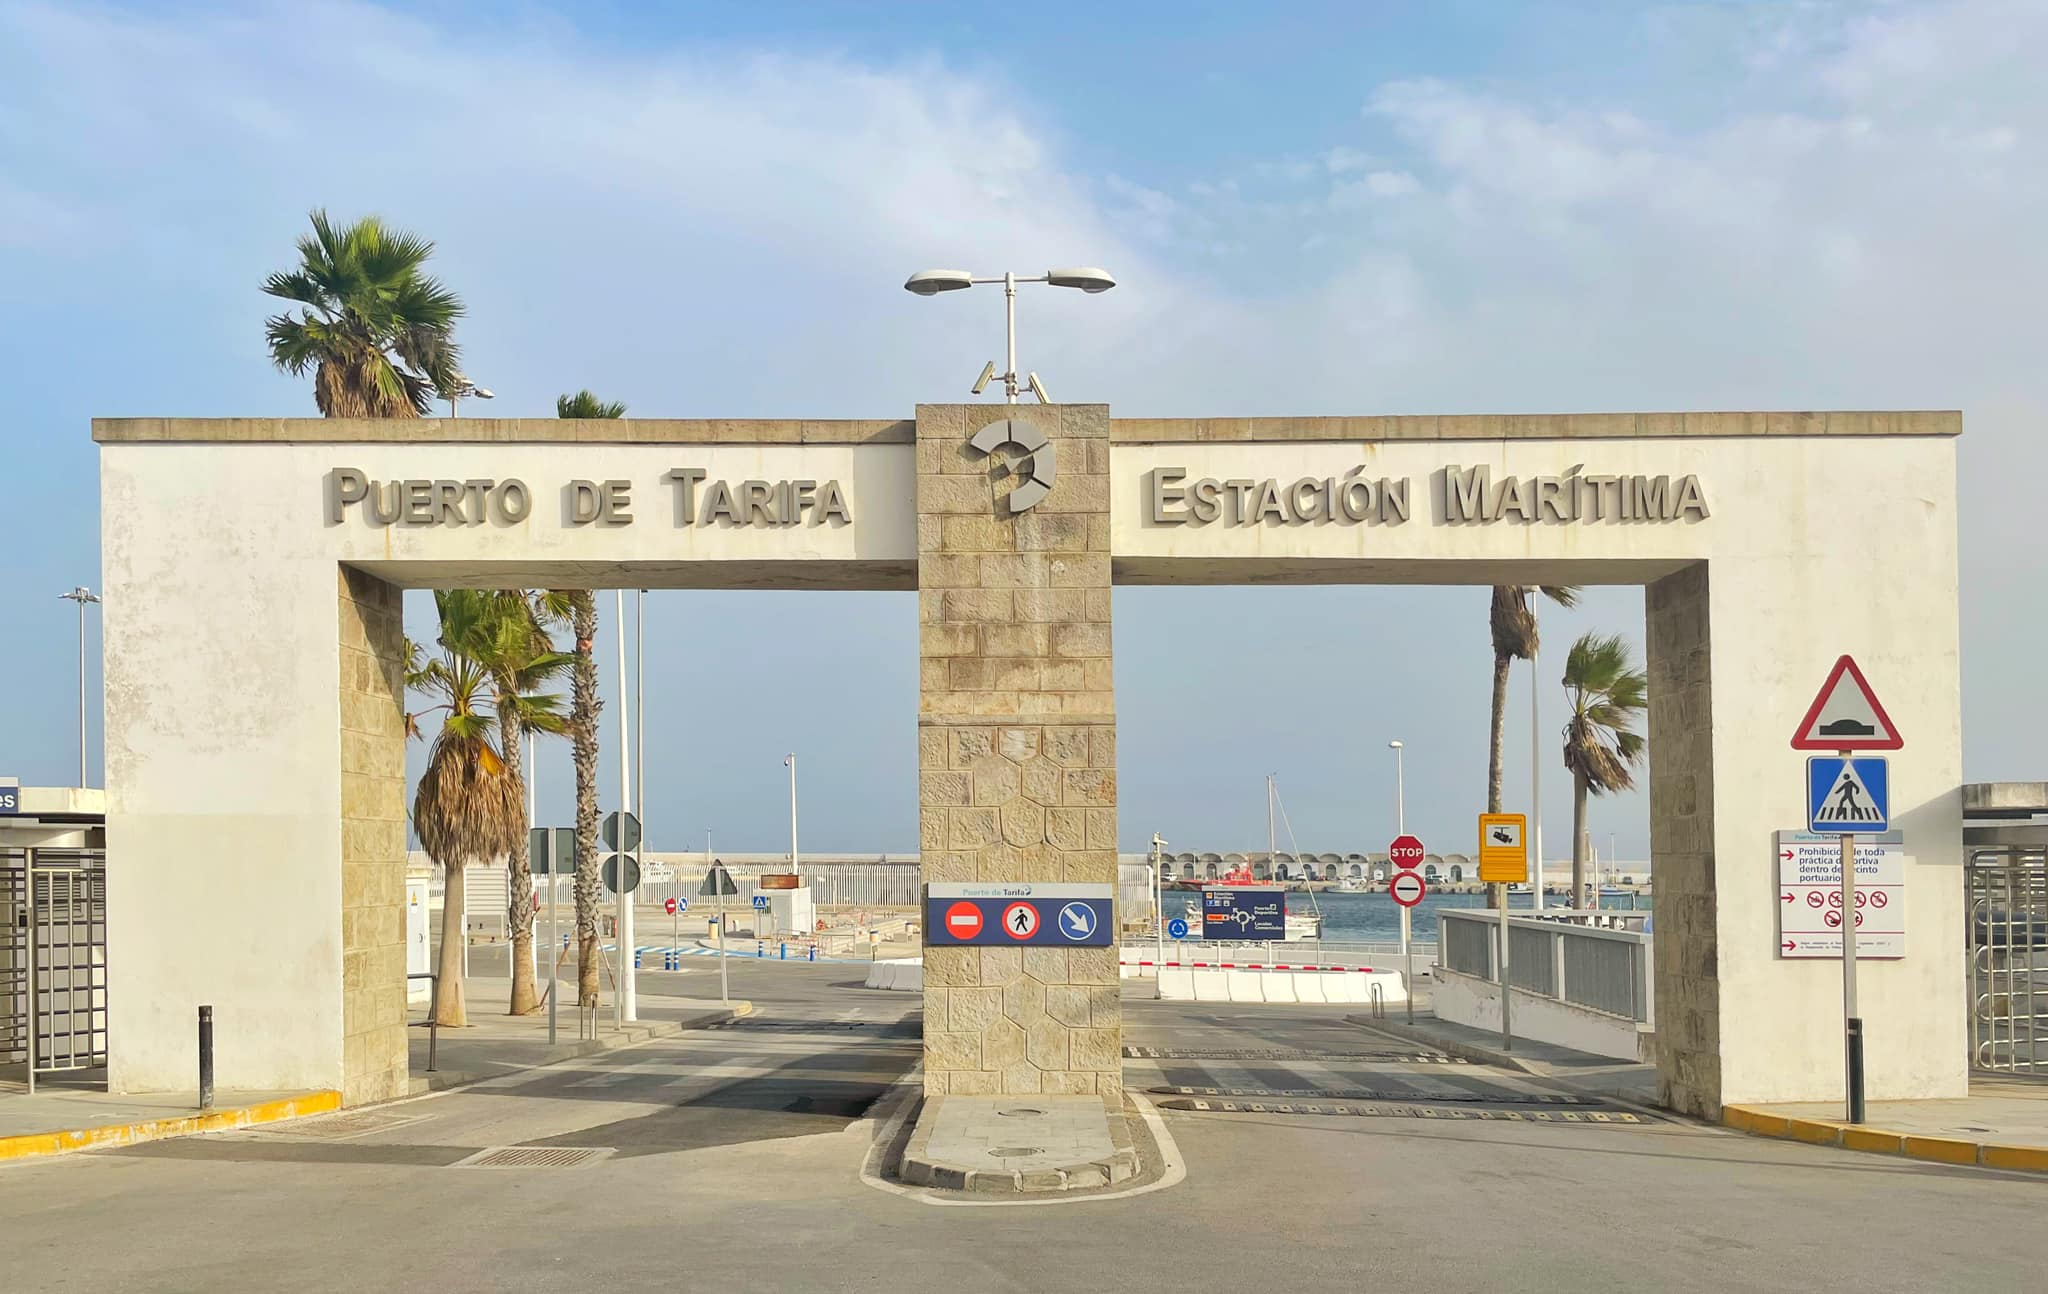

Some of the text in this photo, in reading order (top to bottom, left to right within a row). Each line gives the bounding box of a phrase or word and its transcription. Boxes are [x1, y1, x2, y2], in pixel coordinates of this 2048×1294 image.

[1391, 847, 1423, 857] STOP
[1864, 848, 1885, 856] toda
[1799, 857, 1833, 866] práctica
[1799, 865, 1829, 873] dentro
[1799, 875, 1841, 883] portuario
[962, 888, 1025, 896] Puerto de Tarifa
